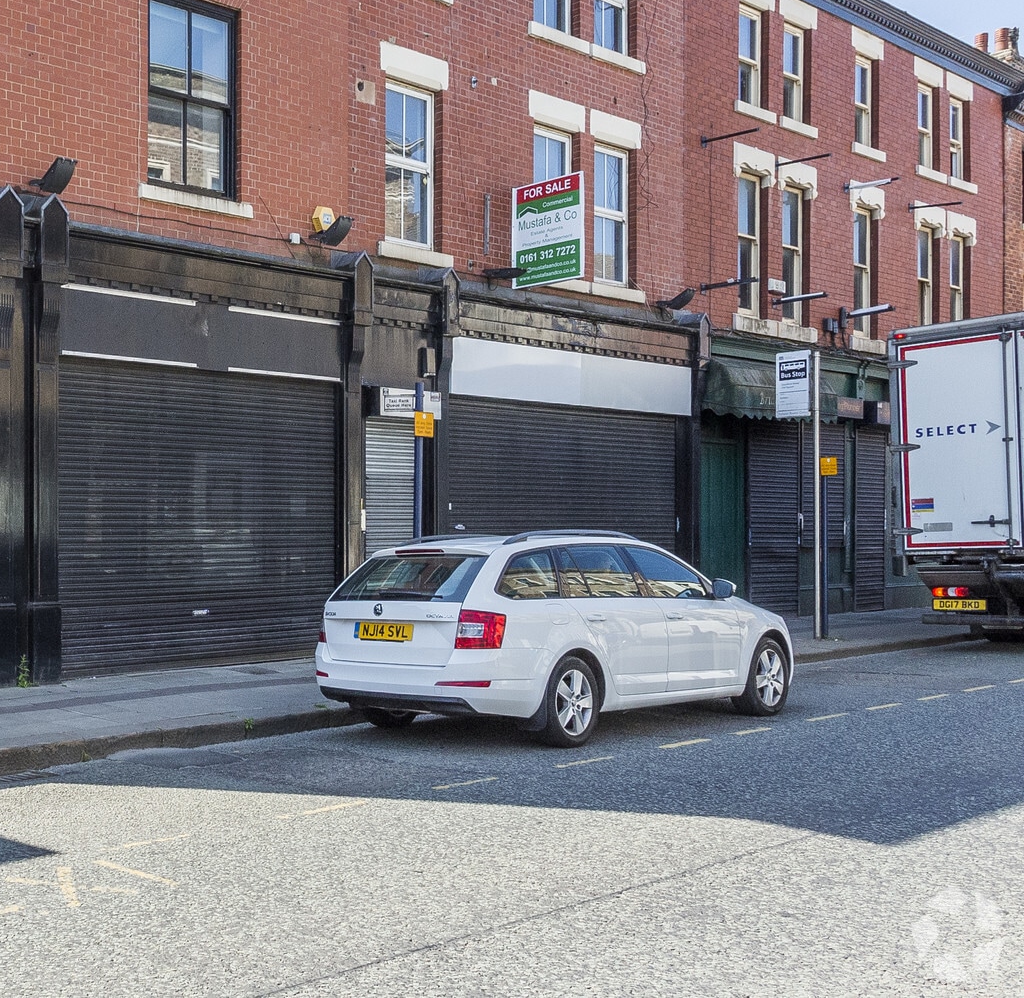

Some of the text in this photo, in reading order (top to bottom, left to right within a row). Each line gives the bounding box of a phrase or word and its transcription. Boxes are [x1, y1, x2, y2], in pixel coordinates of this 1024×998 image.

[523, 178, 572, 200] FOR SALE
[542, 195, 574, 208] Commercial
[518, 209, 578, 231] Mustafa & Co
[519, 244, 576, 264] 0161 312 7272
[791, 370, 806, 379] Stop
[915, 423, 977, 438] SELECT
[939, 600, 980, 609] DG17 BKD
[362, 624, 409, 639] NJ14 SVL
